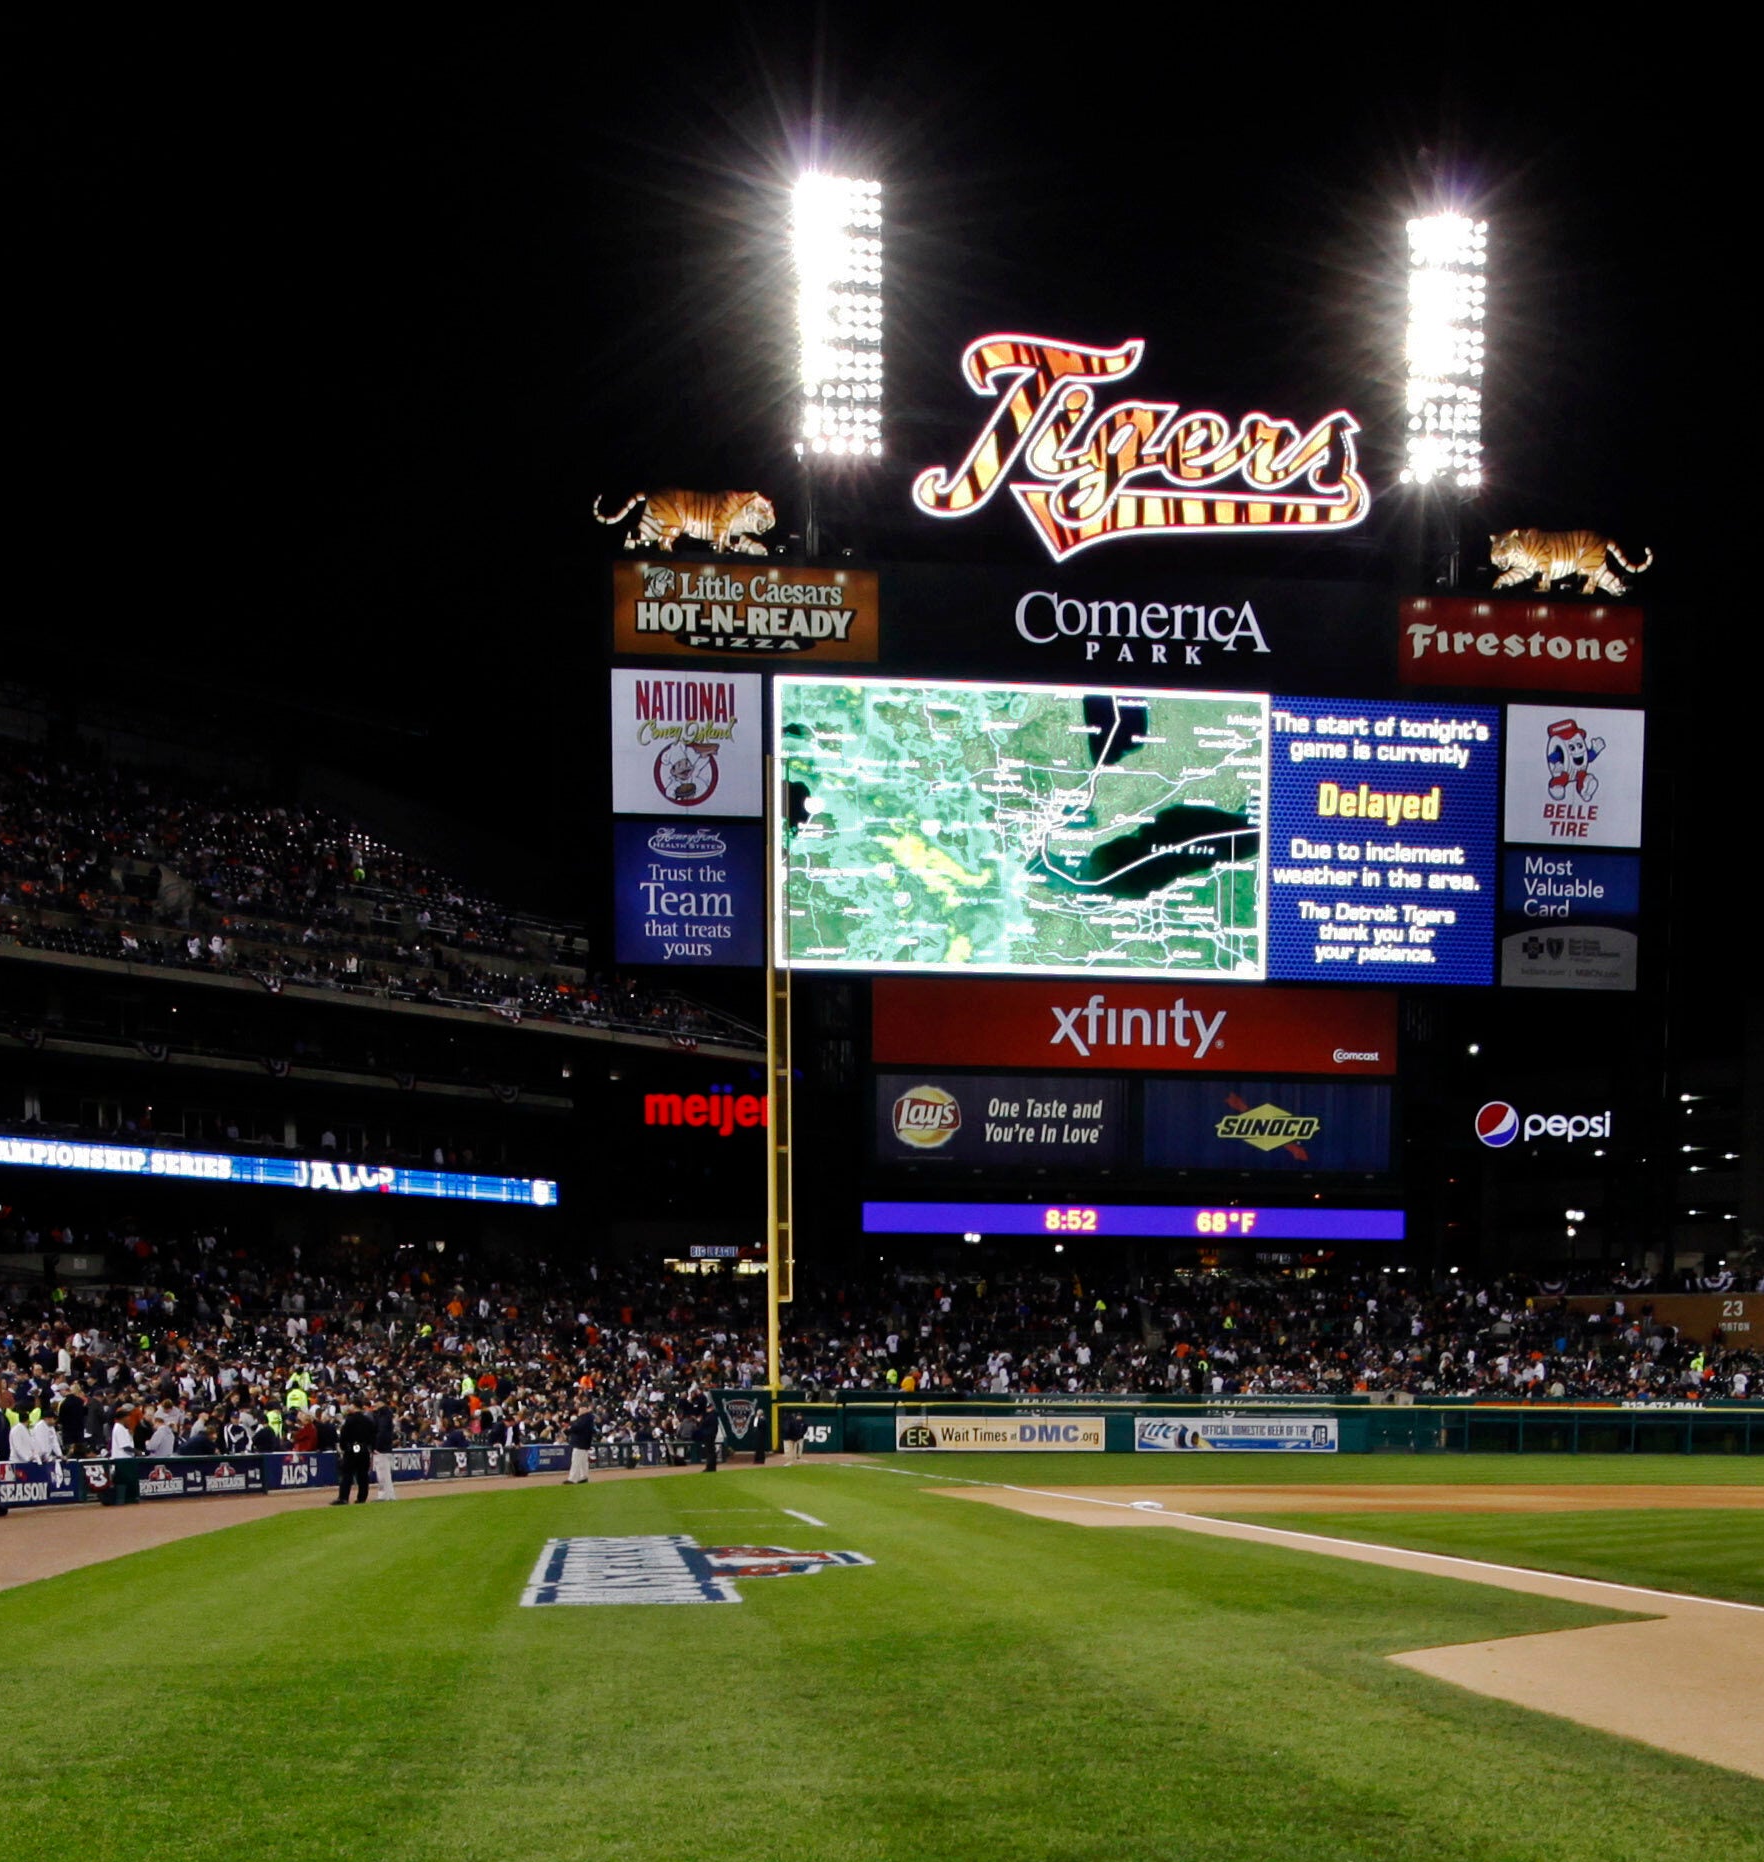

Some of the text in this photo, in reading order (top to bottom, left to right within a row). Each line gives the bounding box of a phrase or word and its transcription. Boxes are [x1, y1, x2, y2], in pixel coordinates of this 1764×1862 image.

[912, 334, 1370, 562] Tigers
[680, 573, 843, 606] Little Caesars
[637, 601, 854, 640] HOT-N-READY
[690, 636, 801, 650] PIZZA
[1085, 641, 1203, 665] PARK
[1406, 622, 1629, 663] Firestone
[1272, 711, 1310, 733] The
[1316, 716, 1369, 735] start
[1374, 717, 1396, 737] of
[1400, 719, 1490, 744] tonight's
[1290, 739, 1470, 769] game is currently
[1318, 782, 1442, 826] Delayed
[1543, 803, 1598, 820] BELLE
[1549, 821, 1590, 838] TIRE
[652, 841, 686, 849] HEALTH
[1151, 843, 1215, 854] Lake Erie
[1291, 838, 1466, 865] Due to inclement
[648, 864, 726, 883] Trust the
[1525, 856, 1573, 875] Most
[1273, 866, 1481, 891] weather in the area.
[1524, 878, 1604, 898] Valuable
[640, 882, 735, 917] Team
[1524, 899, 1570, 918] Card
[1298, 901, 1456, 926] The Detroit Tigers
[644, 919, 732, 938] that treats
[1319, 923, 1435, 945] thank you for
[663, 942, 713, 959] yours
[1315, 944, 1436, 965] your patience.
[1050, 994, 1228, 1059] xfinity
[898, 1098, 955, 1131] Lay's
[988, 1098, 1103, 1119] One Taste and
[985, 1123, 1099, 1143] You're In Love
[1221, 1117, 1315, 1137] SUNOCO
[1524, 1111, 1611, 1142] pepsi
[151, 1153, 232, 1179] SERIES
[1045, 1209, 1256, 1233] 8:52 68°F
[1723, 1301, 1744, 1317] 23
[803, 1426, 831, 1443] 45'
[906, 1428, 930, 1446] ER
[941, 1427, 969, 1442] Wait
[973, 1427, 1007, 1442] Times
[1140, 1421, 1178, 1441] Lite
[1201, 1424, 1308, 1436] OFFICIAL DOMESTIC BEER OF THE
[281, 1464, 308, 1485] ALCS
